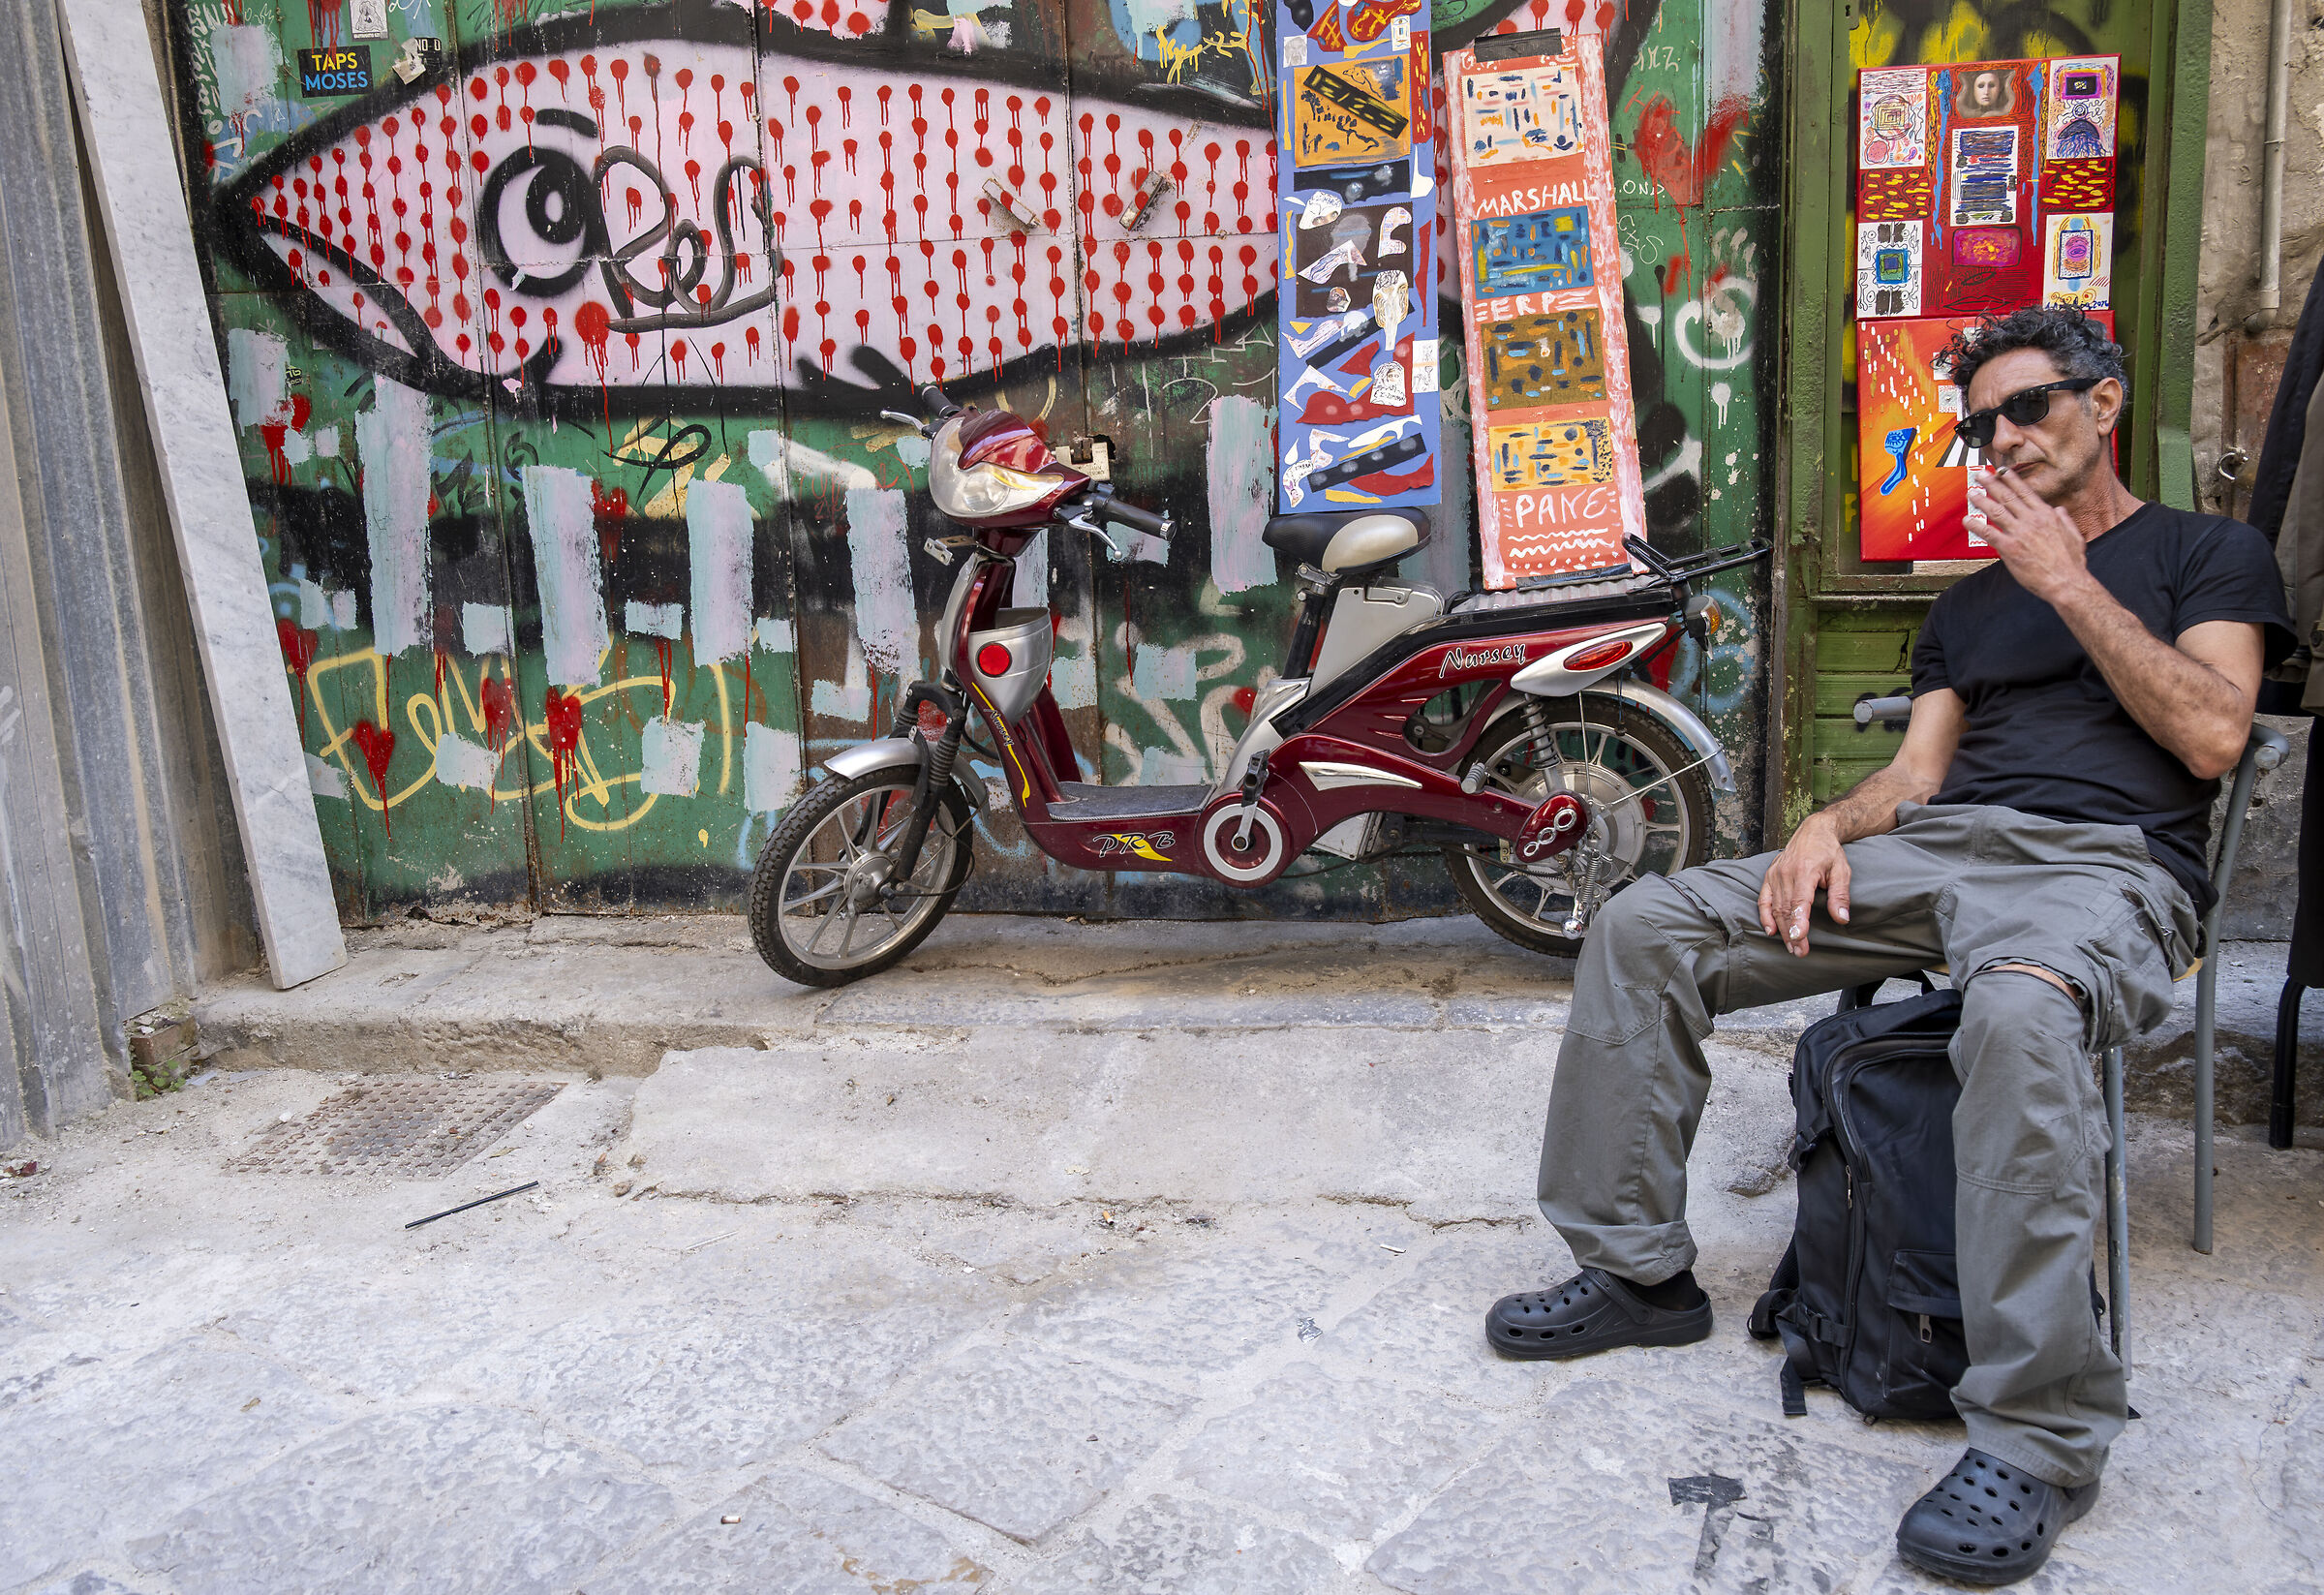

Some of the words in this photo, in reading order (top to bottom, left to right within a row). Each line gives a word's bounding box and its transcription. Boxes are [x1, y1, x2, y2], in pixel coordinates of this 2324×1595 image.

[311, 51, 358, 72] TAPS
[304, 71, 369, 92] MOSES
[1474, 178, 1601, 221] MARSHALL
[1438, 643, 1526, 679] Nursey
[1092, 830, 1177, 859] PRB
